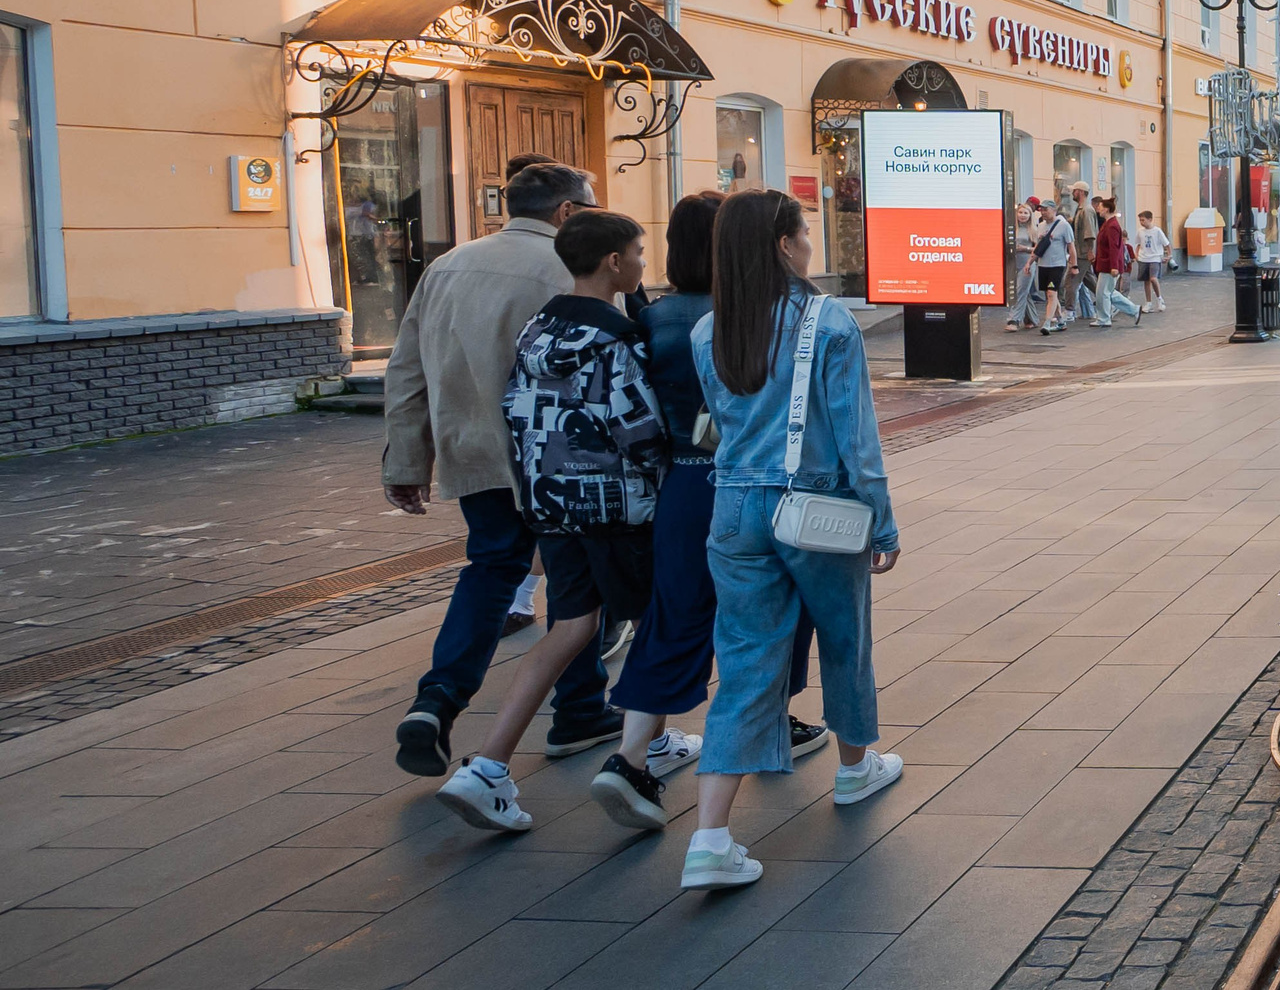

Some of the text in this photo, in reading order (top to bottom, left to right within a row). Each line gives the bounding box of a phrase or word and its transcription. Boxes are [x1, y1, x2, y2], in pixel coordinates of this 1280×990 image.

[893, 146, 972, 160] Савин парк
[885, 161, 982, 175] Новый корпус
[248, 187, 273, 198] 24/7
[909, 234, 961, 247] Готовая
[908, 252, 963, 263] отделка
[964, 283, 995, 295] ПИК
[799, 316, 816, 360] GUESS
[568, 501, 621, 510] Fashon
[808, 514, 864, 536] GUESS
